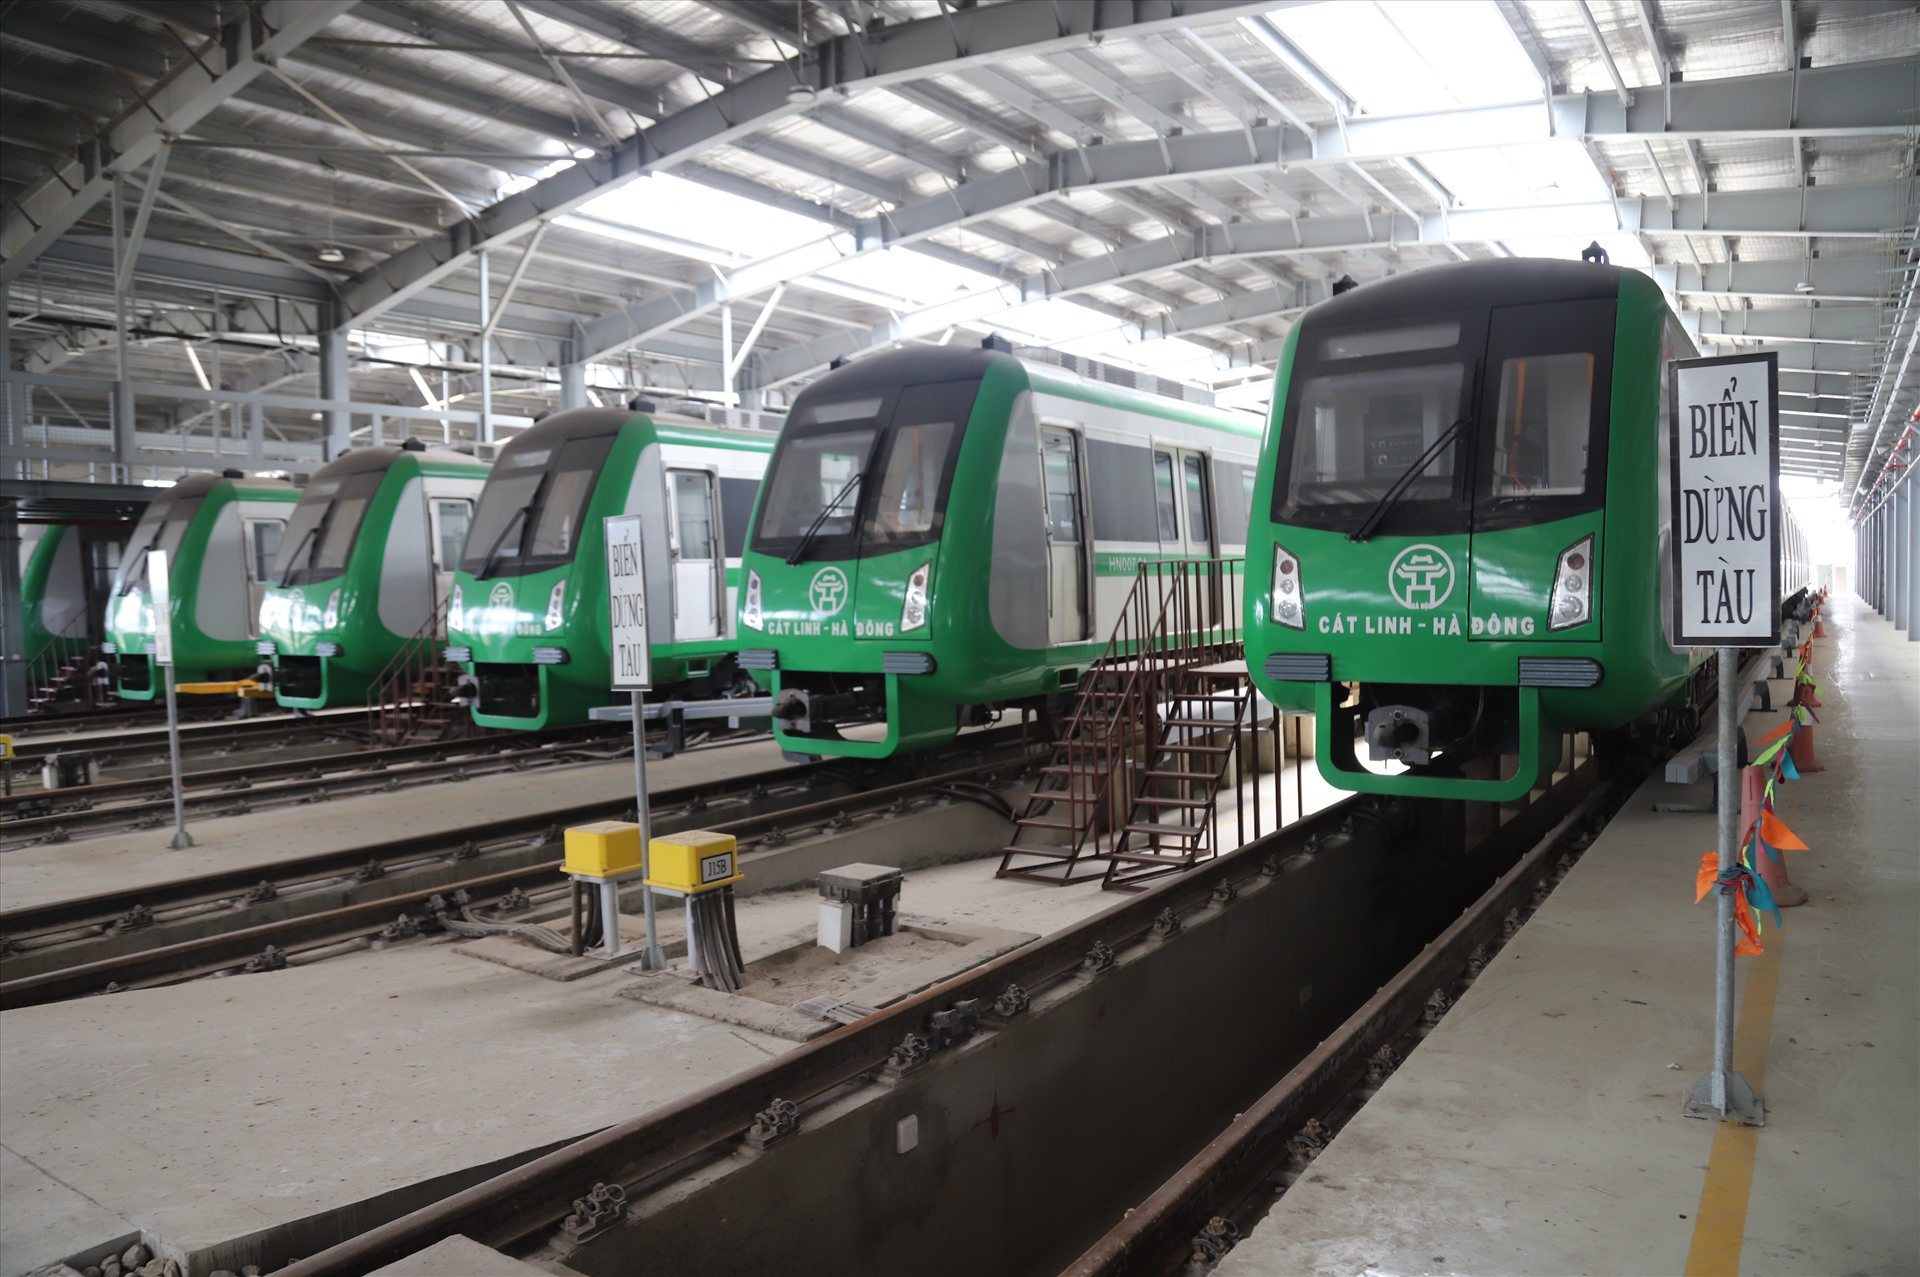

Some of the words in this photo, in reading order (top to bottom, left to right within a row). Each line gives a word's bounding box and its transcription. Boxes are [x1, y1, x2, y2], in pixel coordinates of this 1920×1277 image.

[1688, 376, 1759, 458] BIỂN
[1683, 475, 1767, 544] DỪNG
[612, 529, 639, 577] BIỂN
[612, 587, 644, 628] DỪNG
[1696, 556, 1756, 624] TÀU
[767, 619, 791, 635] CÁT
[793, 621, 821, 635] LINH
[831, 619, 848, 636] HÀ
[855, 619, 894, 637] ĐÔNG
[1318, 612, 1358, 634] CÁT
[1365, 616, 1412, 635] LINH
[1432, 614, 1462, 636] HÀ
[1471, 612, 1535, 636] ĐÔNG
[618, 636, 641, 677] TÀU
[708, 859, 727, 877] J15B
